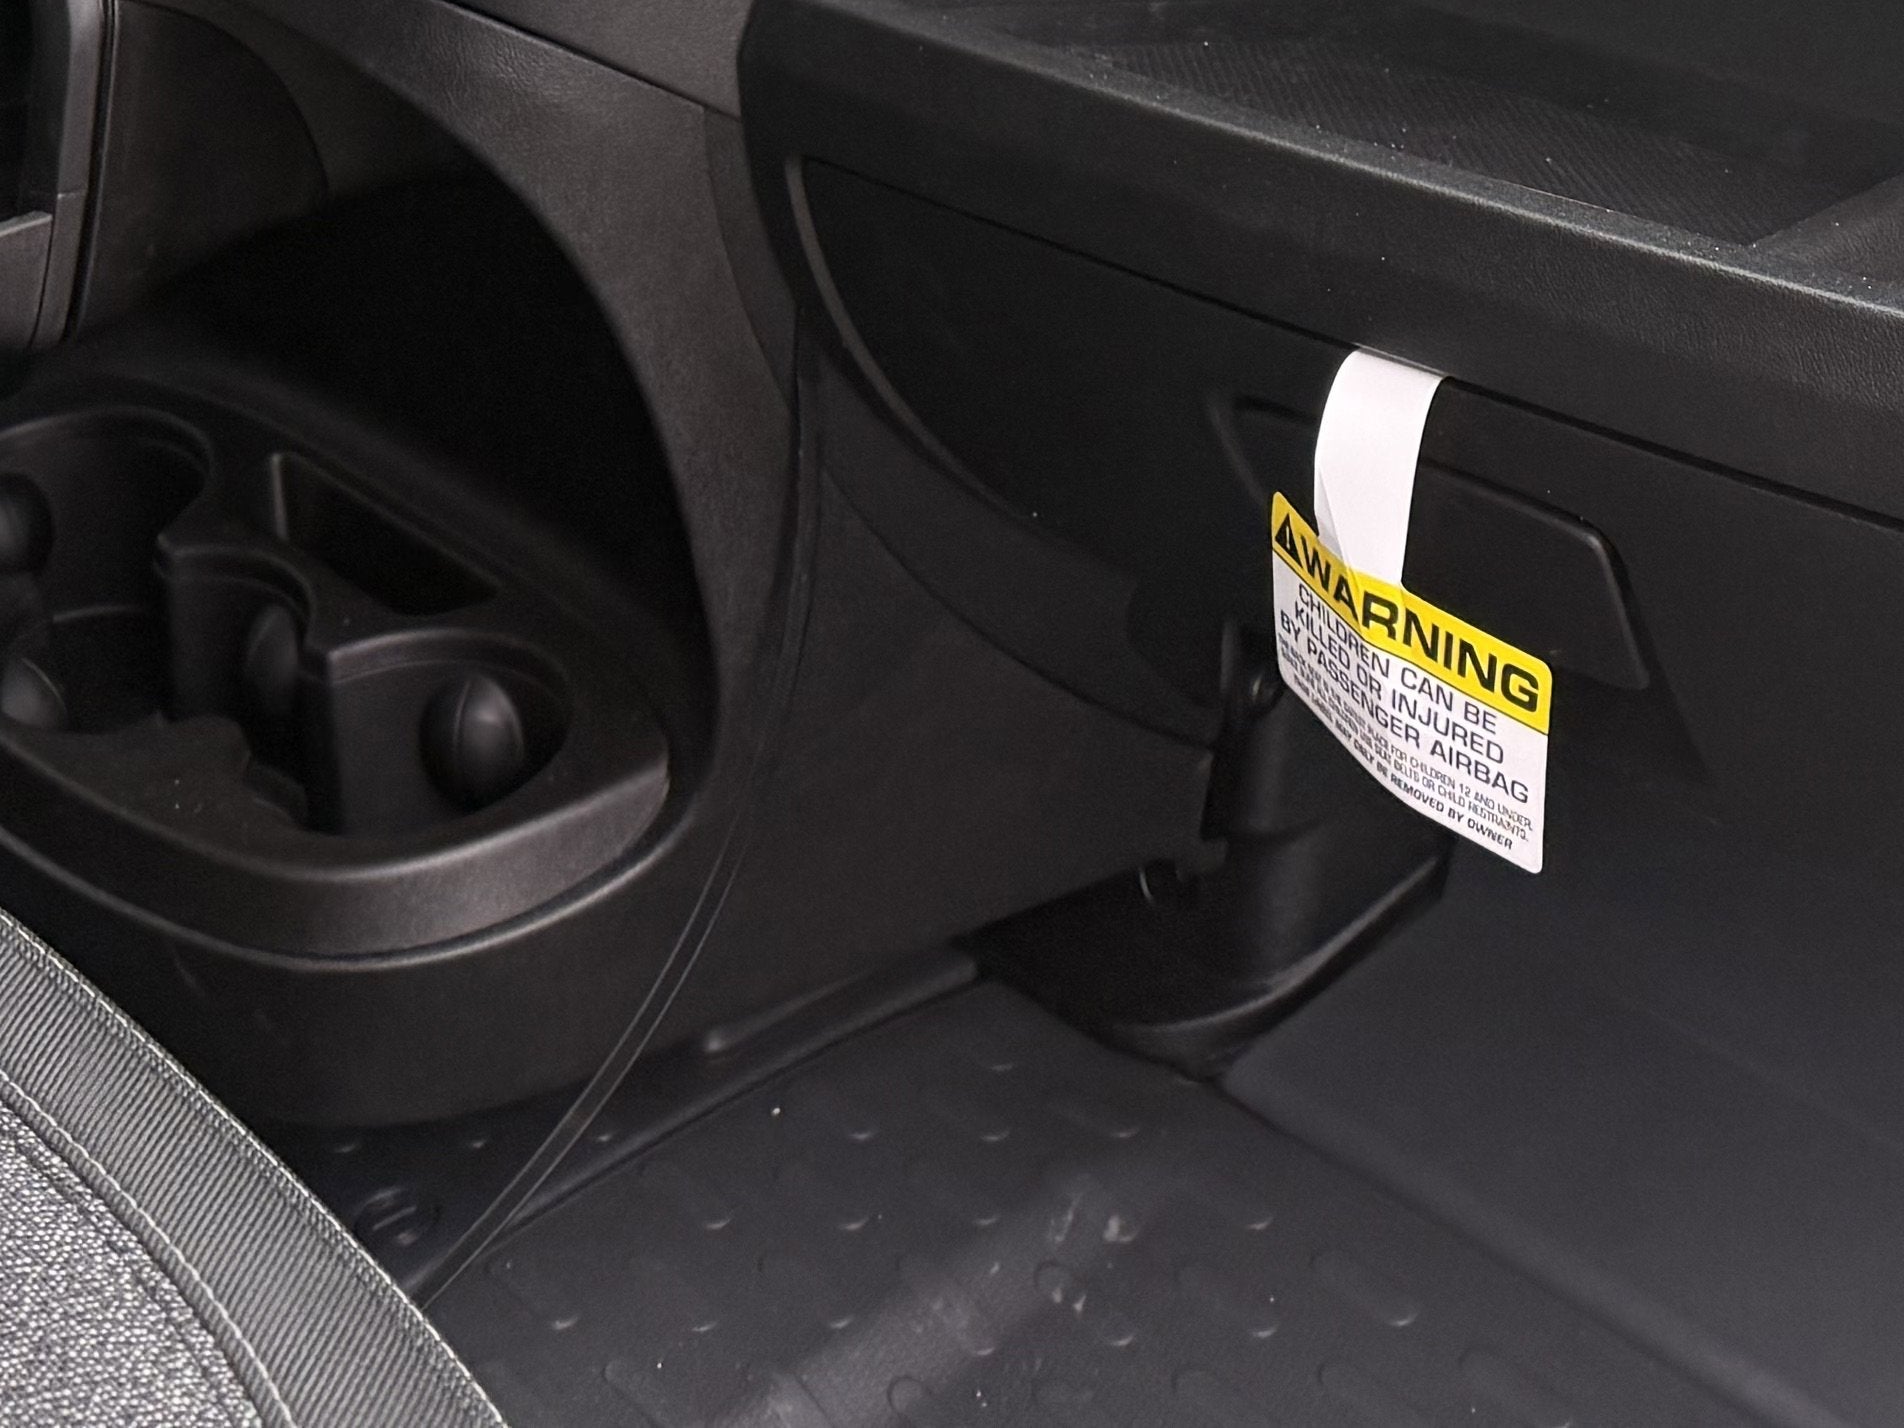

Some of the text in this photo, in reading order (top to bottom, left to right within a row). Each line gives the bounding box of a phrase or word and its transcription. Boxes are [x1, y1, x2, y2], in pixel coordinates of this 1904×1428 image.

[1295, 600, 1351, 671] KILLED
[1356, 664, 1382, 701] OR
[1391, 688, 1505, 765] INJURED
[1299, 582, 1390, 679] CHILDREN
[1400, 666, 1454, 712] CAN
[1463, 701, 1498, 735] BE
[1300, 534, 1540, 714] WARNING
[1280, 609, 1301, 643] BY
[1307, 637, 1421, 751] PASSENGER
[1429, 739, 1529, 804] AIRBAG
[1390, 772, 1445, 813] REMOVED
[1447, 806, 1465, 824] BY
[1467, 814, 1514, 851] OWNER
[1459, 782, 1471, 798] 12
